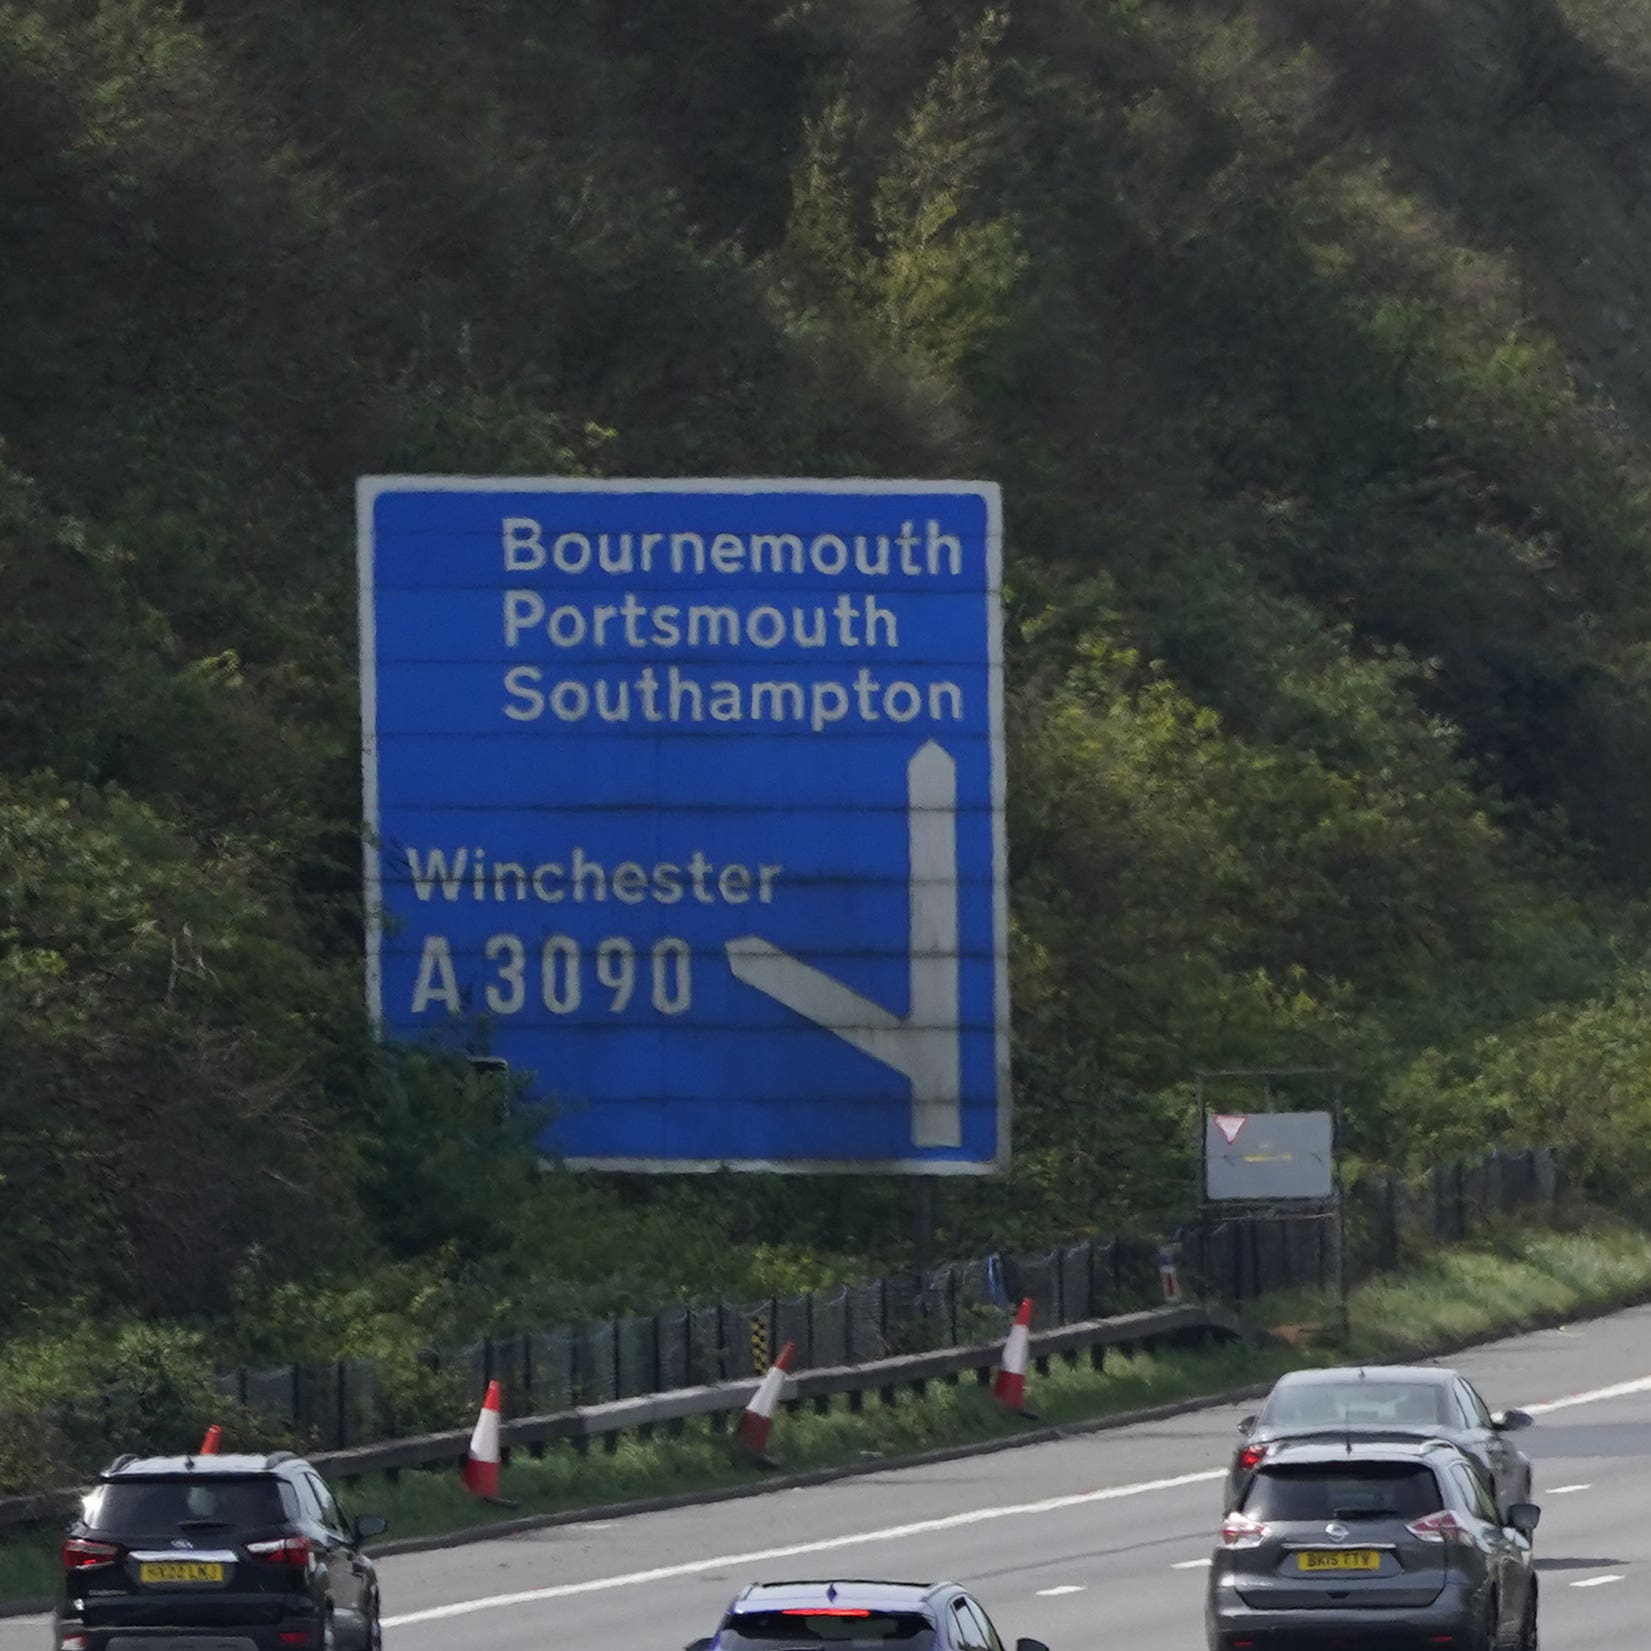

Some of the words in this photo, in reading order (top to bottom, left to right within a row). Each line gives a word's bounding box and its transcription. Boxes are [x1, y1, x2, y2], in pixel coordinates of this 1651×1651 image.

[501, 516, 963, 576] Bournemouth
[503, 590, 899, 648] Portsmouth
[504, 666, 965, 732] Southampton
[405, 847, 783, 904] Winchester
